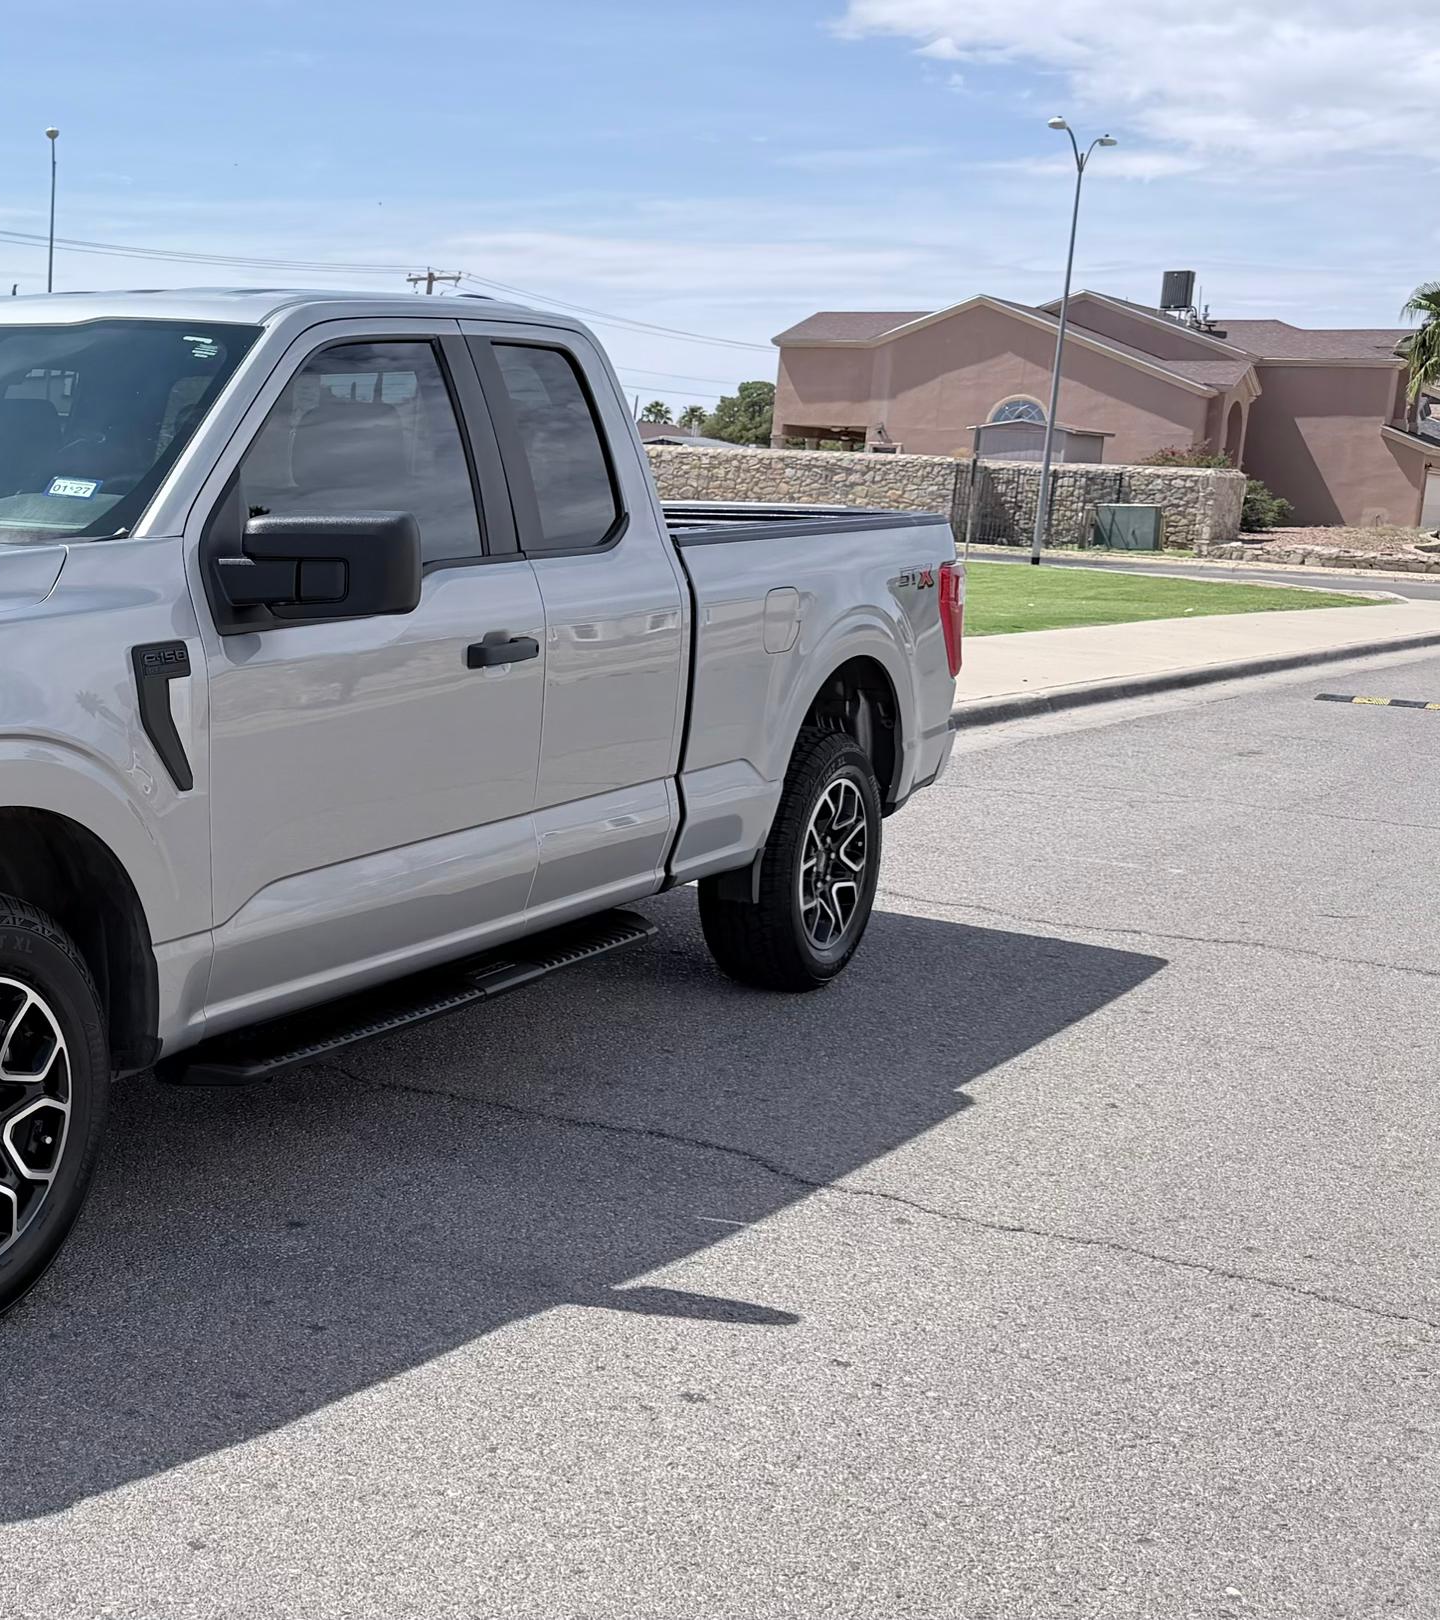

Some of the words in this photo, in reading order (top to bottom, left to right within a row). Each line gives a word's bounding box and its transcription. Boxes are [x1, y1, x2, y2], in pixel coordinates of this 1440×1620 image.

[52, 484, 68, 493] 01
[73, 486, 91, 495] 27
[13, 935, 34, 954] XL
